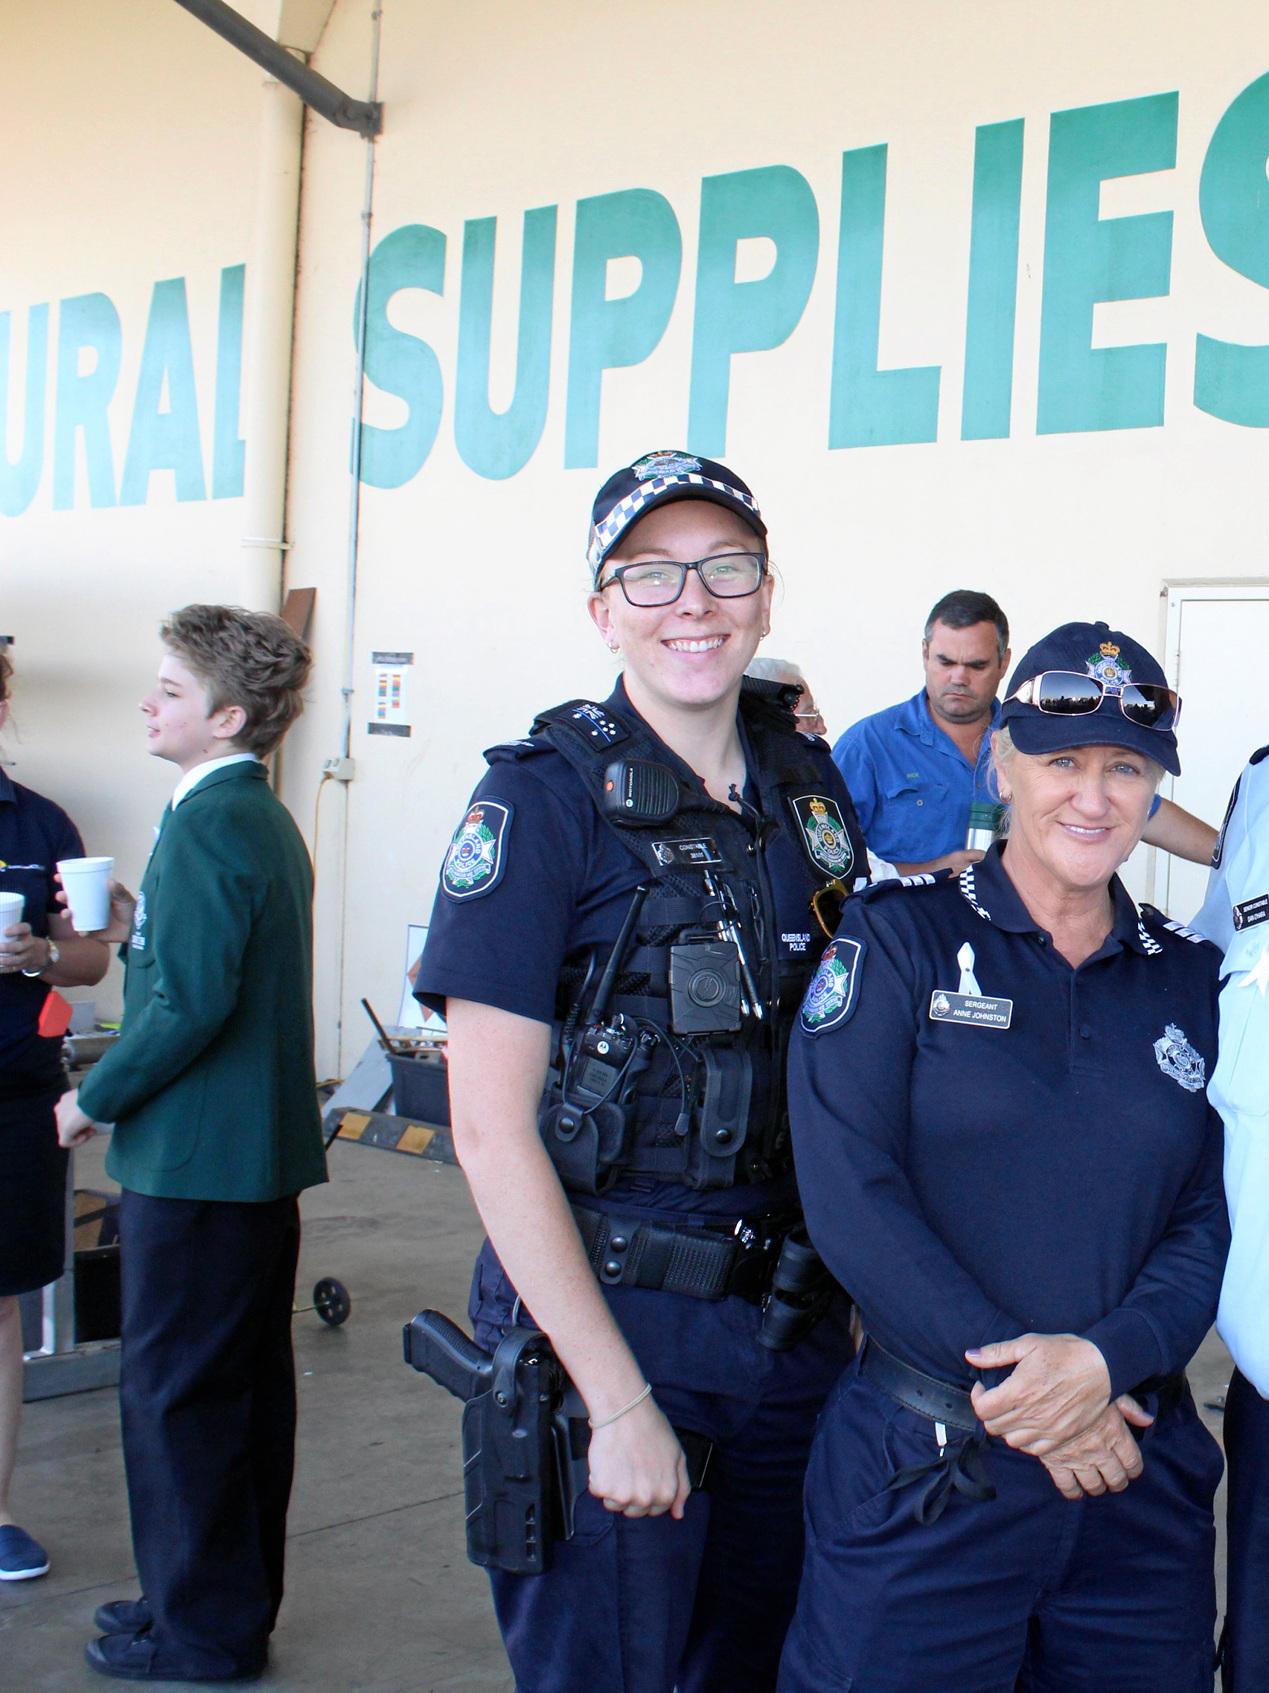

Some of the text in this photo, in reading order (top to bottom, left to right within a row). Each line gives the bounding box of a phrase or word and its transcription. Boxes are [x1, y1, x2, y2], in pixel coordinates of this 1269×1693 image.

[789, 942, 806, 951] POLICE
[964, 1000, 998, 1010] SERGEANT
[953, 1009, 1007, 1022] ANNE JOHNSTON
